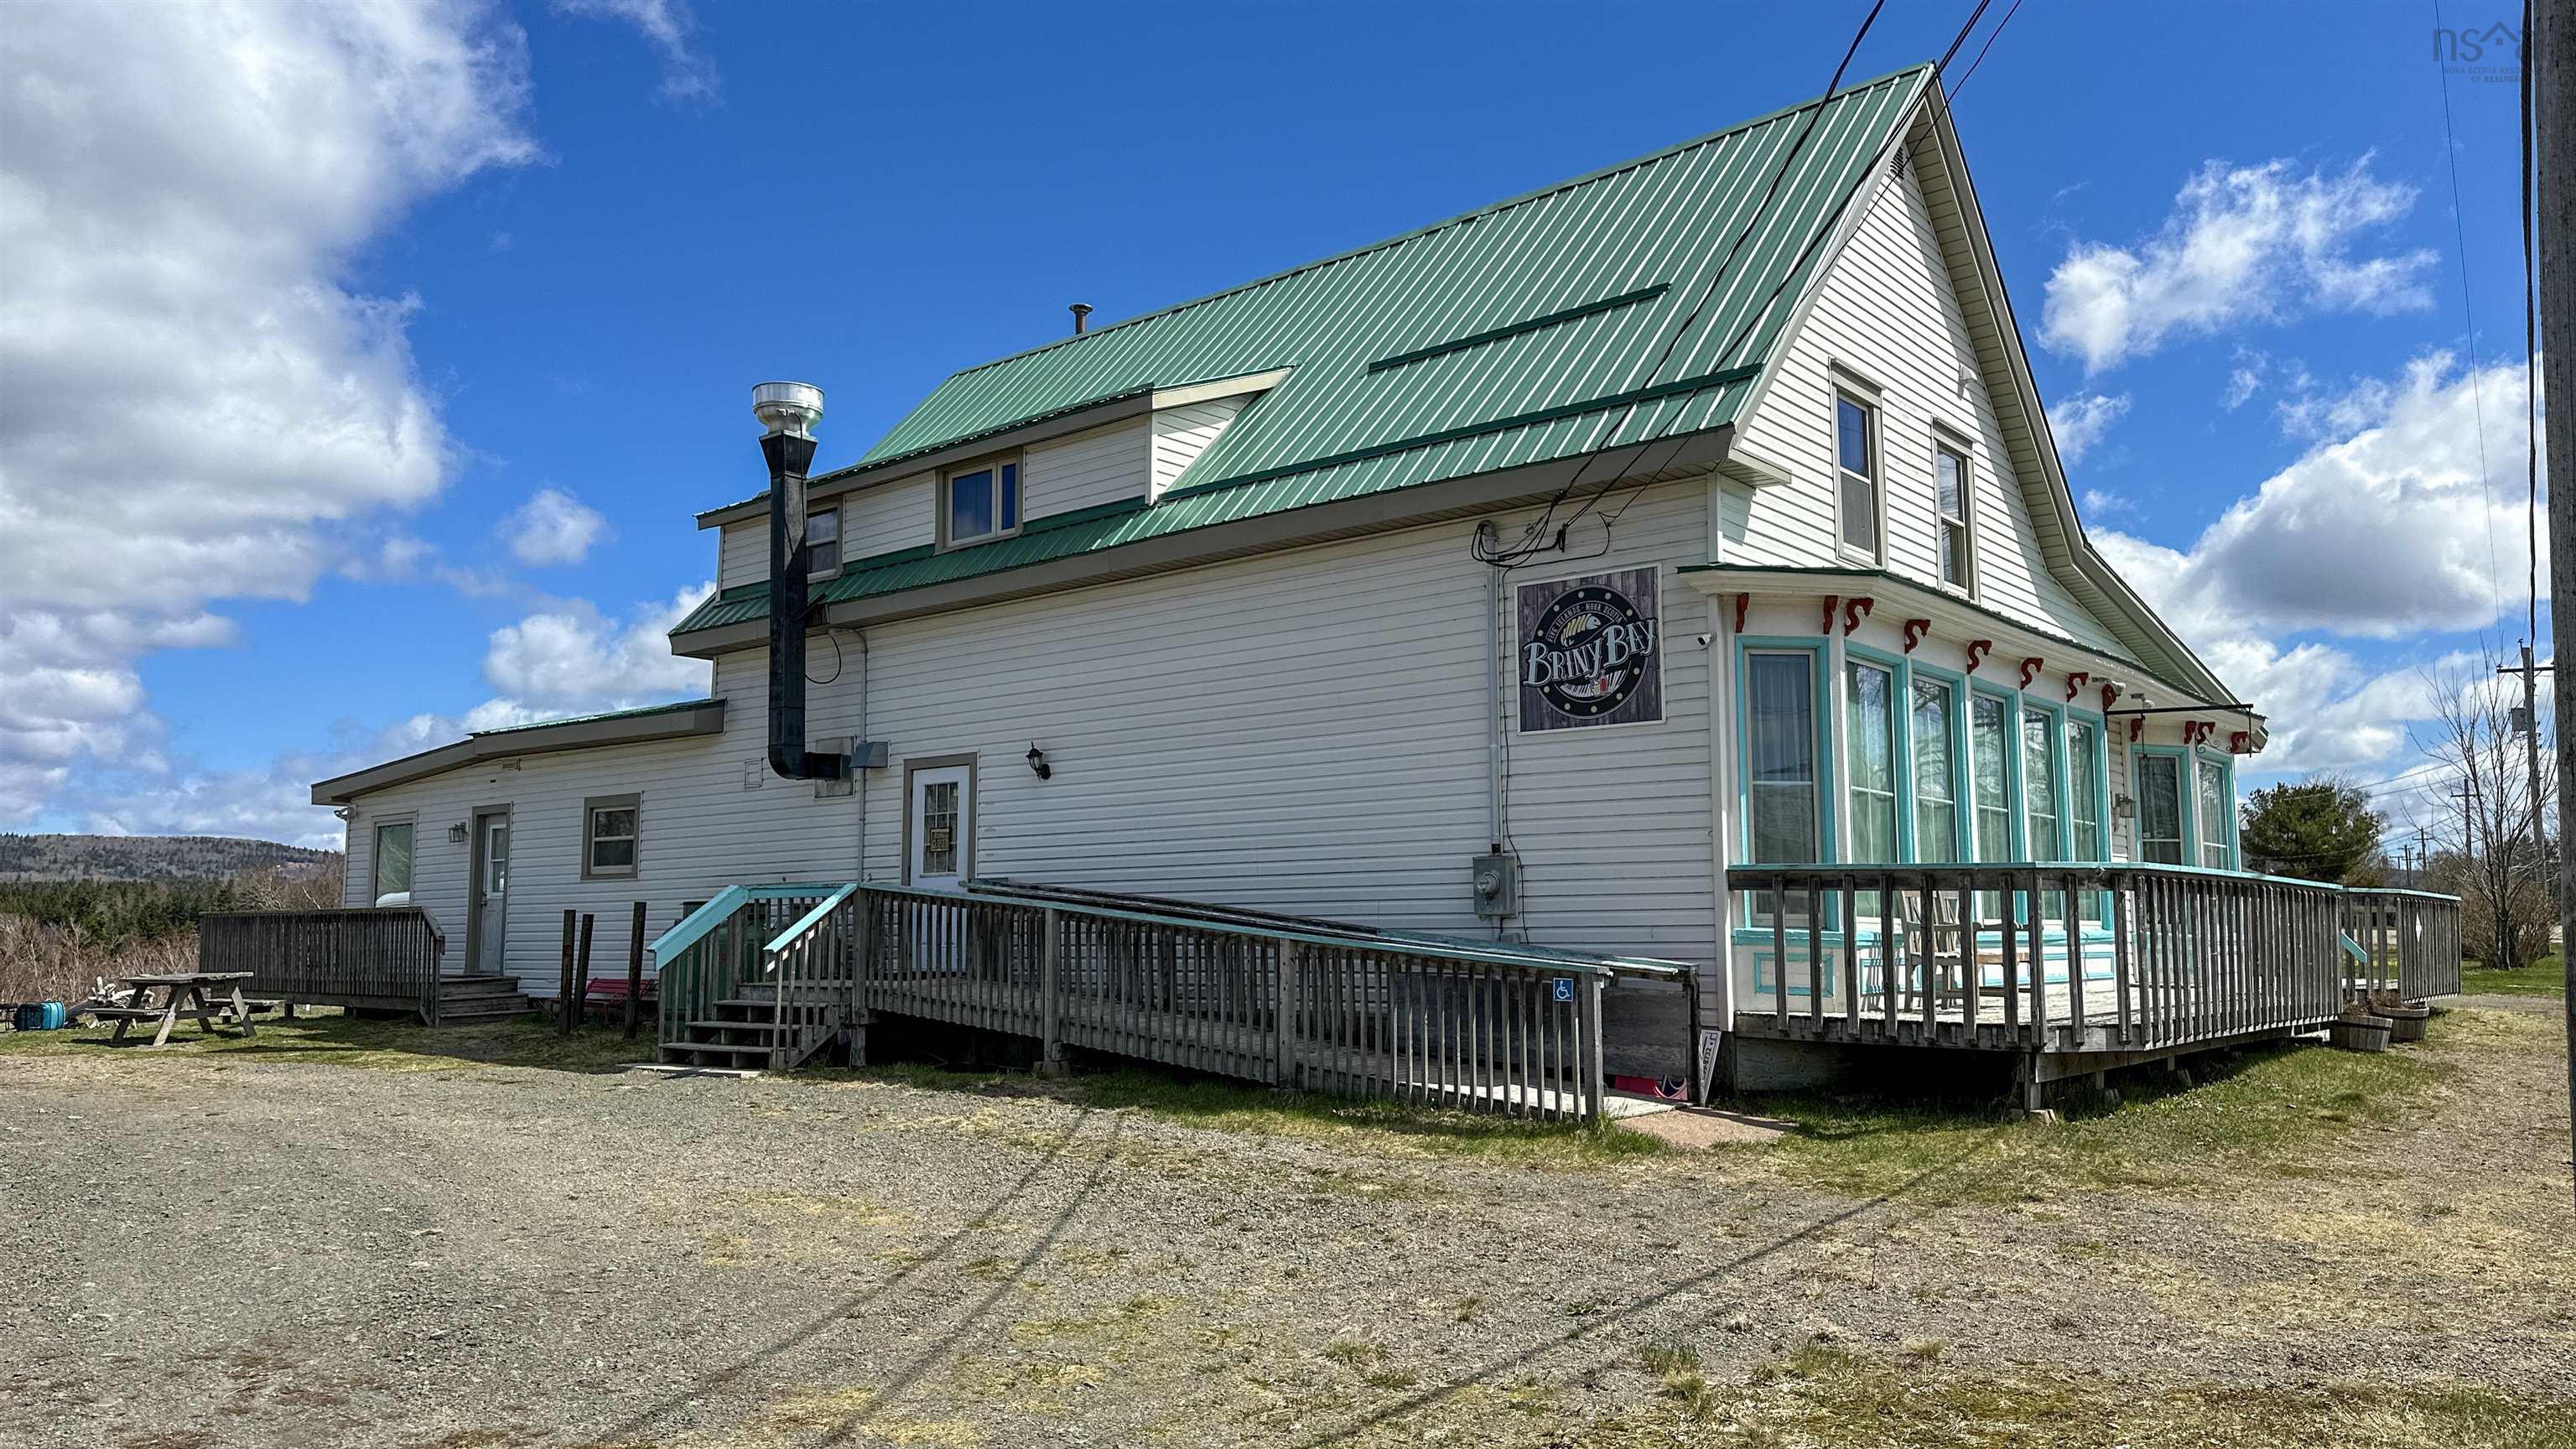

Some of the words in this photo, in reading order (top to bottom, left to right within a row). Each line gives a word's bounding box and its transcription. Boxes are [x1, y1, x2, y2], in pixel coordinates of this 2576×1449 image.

[1547, 627, 1558, 643] FIVE
[1557, 605, 1581, 626] ISLANDS
[1586, 603, 1601, 611] NOVA
[1603, 606, 1623, 624] SCOTIA
[1523, 639, 1602, 687] BRINY
[1602, 620, 1657, 668] BAY
